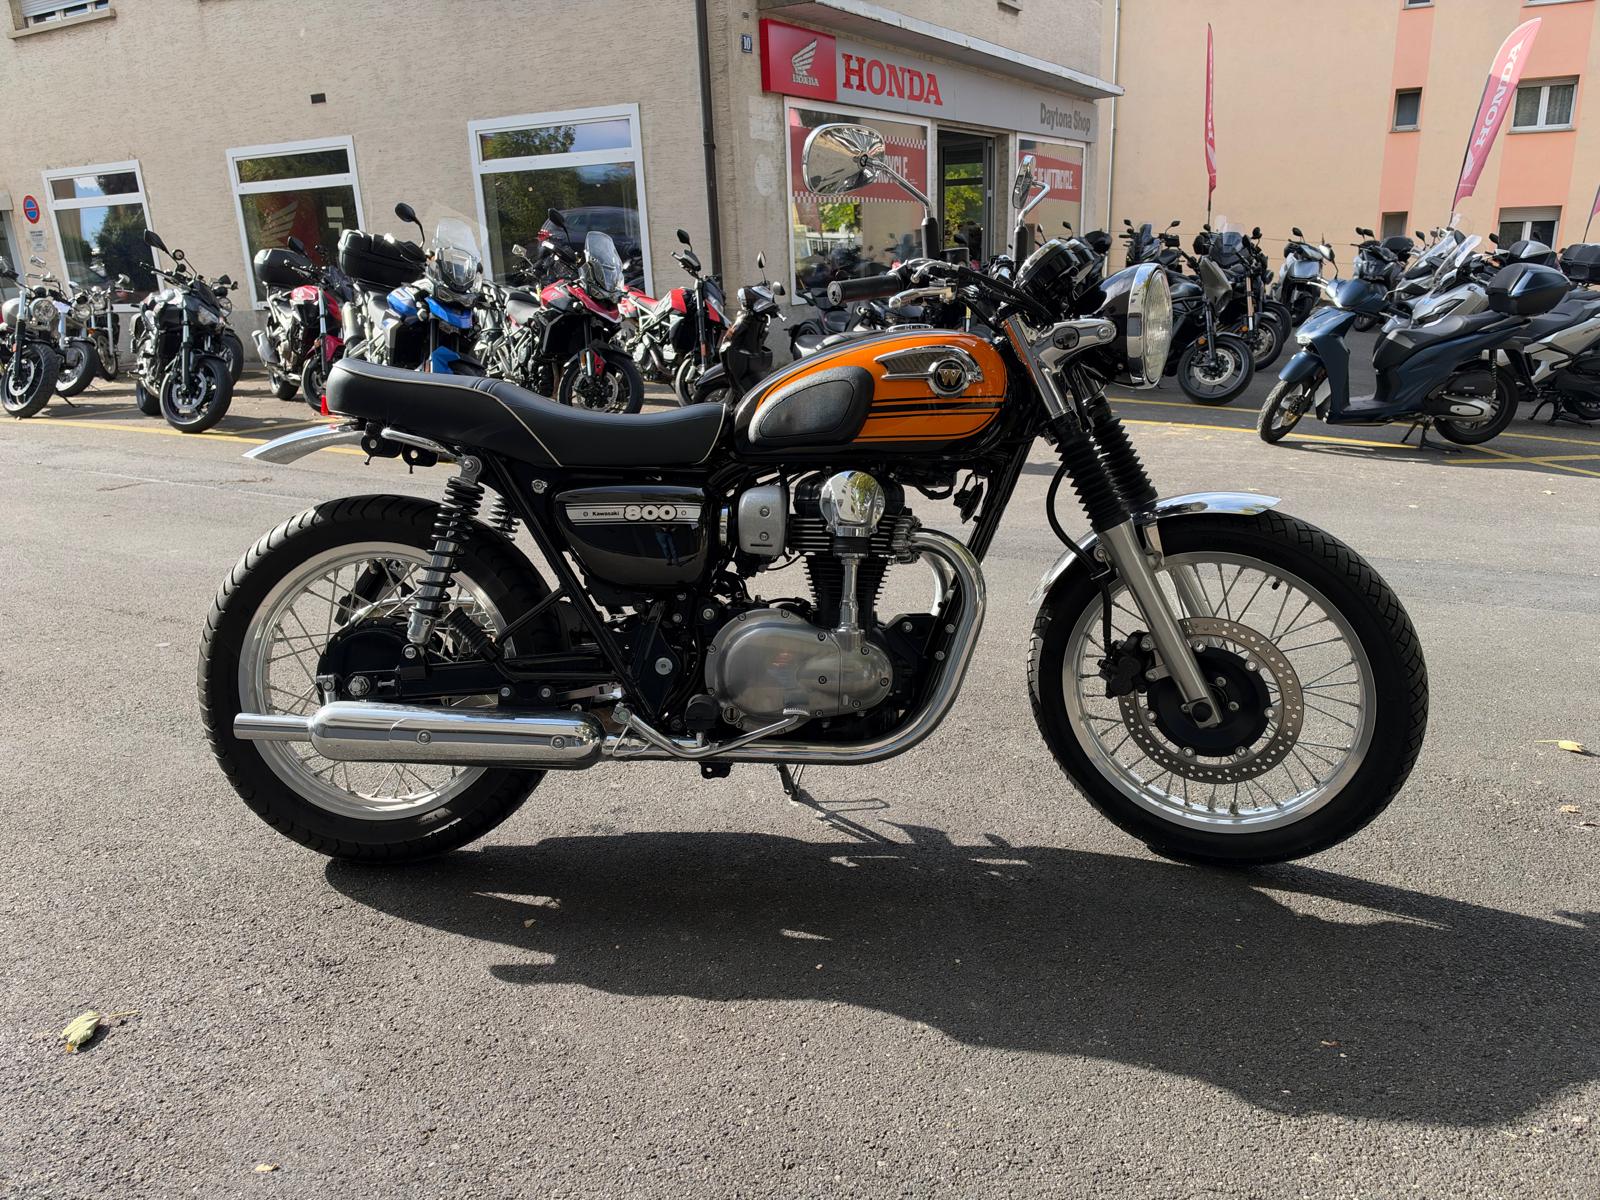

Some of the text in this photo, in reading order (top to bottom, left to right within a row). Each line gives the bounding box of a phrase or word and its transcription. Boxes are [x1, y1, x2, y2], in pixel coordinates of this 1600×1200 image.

[743, 36, 751, 50] 10
[792, 73, 819, 87] HONDA
[842, 53, 943, 106] HONDA
[1474, 38, 1524, 148] HONDA
[1040, 102, 1091, 136] Daytona Shop
[624, 503, 677, 521] 800
